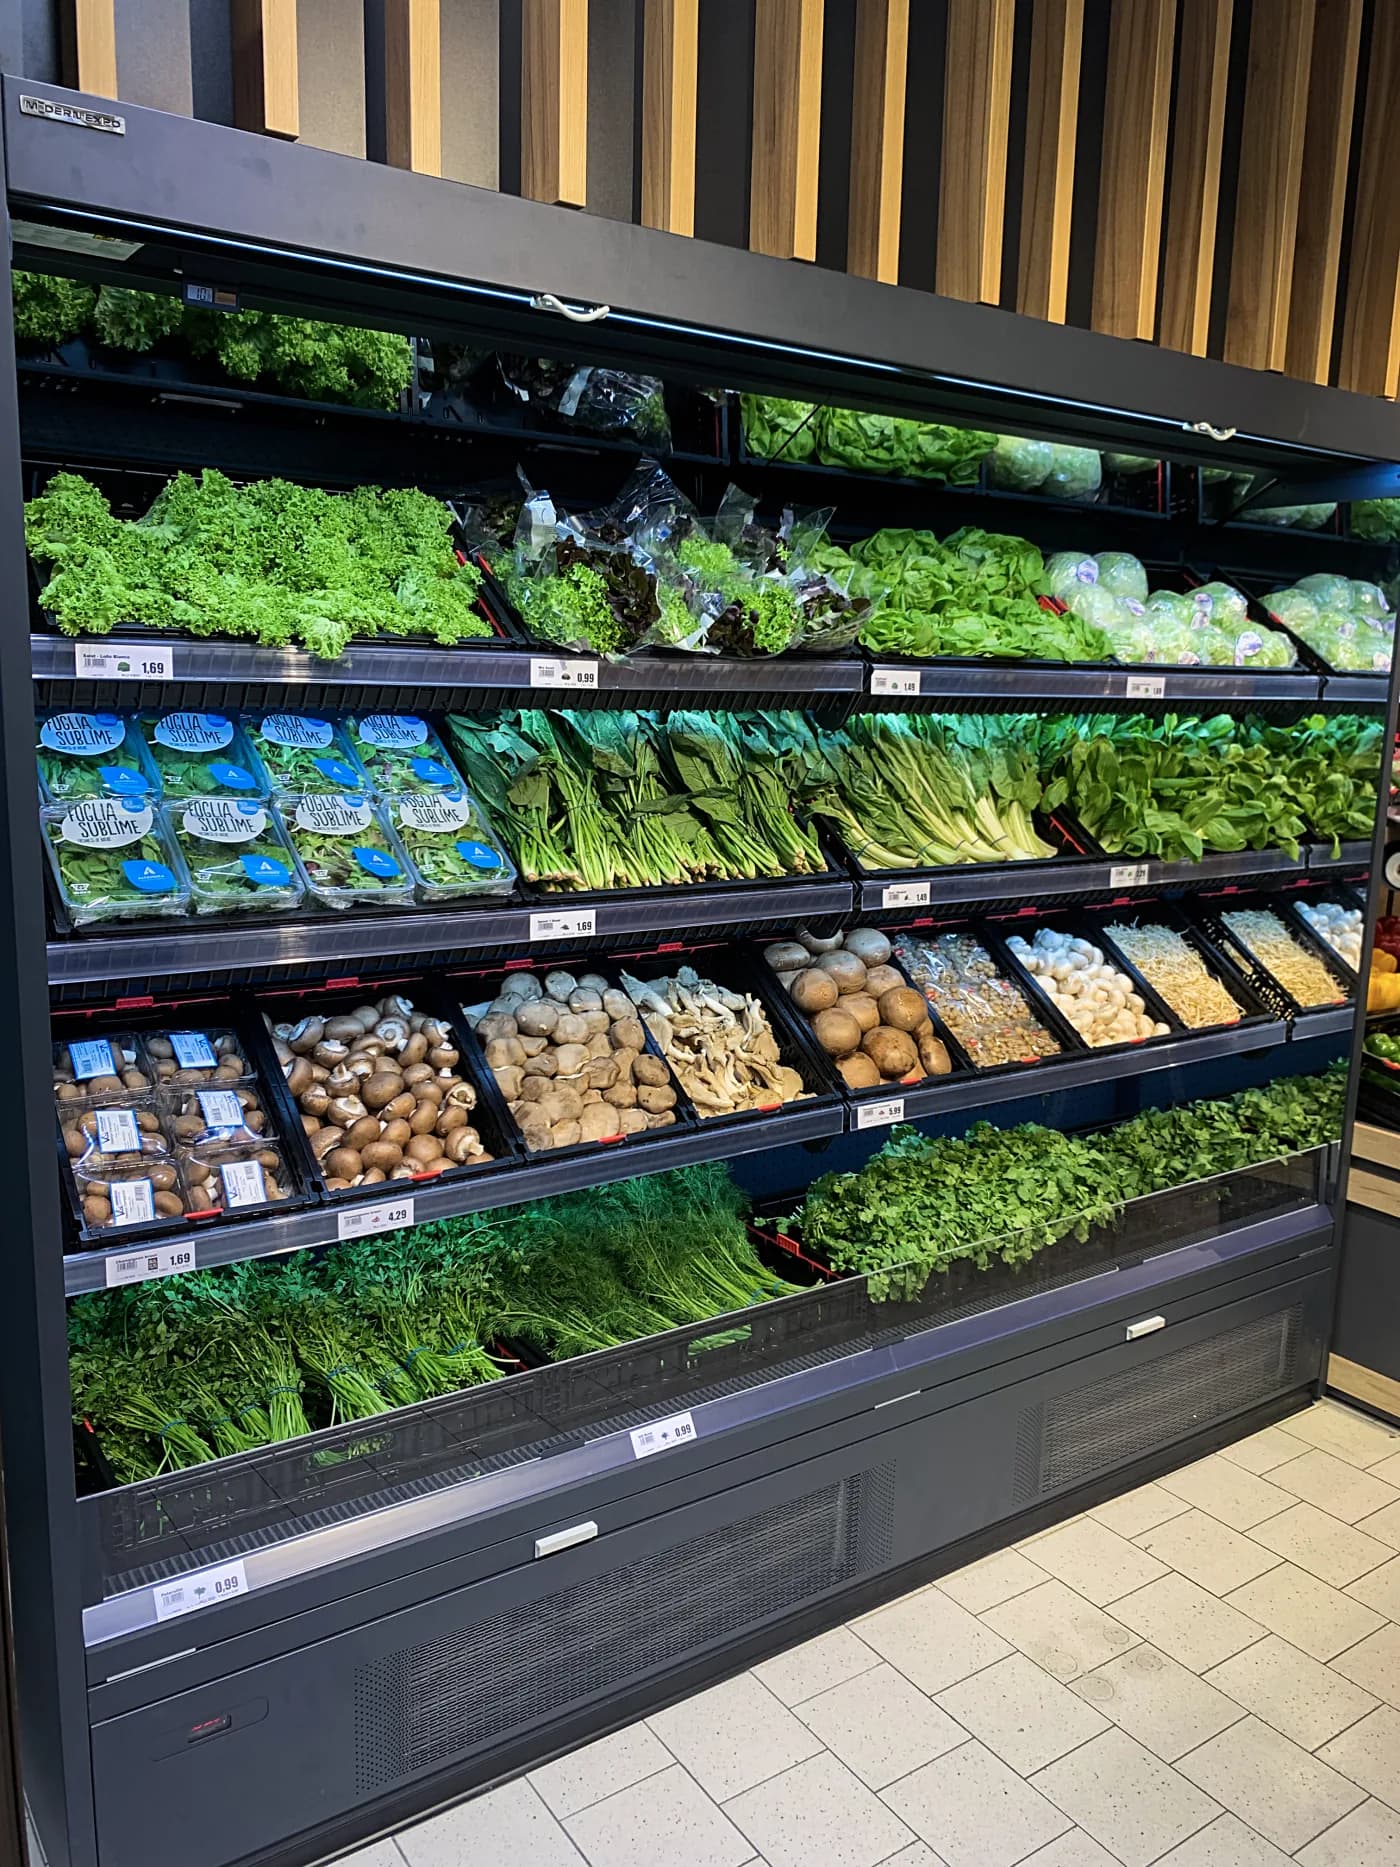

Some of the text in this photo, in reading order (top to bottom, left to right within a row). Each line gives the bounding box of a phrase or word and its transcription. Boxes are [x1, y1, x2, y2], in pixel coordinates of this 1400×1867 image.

[141, 662, 164, 674] 1,69
[577, 673, 594, 683] 0,99
[56, 729, 116, 746] SUBLIME
[169, 729, 225, 744] SUBLIME
[274, 725, 326, 745] SUBLIME
[371, 727, 420, 742] SUBLIME
[310, 810, 365, 827] SUBLIME
[412, 808, 464, 824] SUBLIME
[78, 820, 142, 838] SUBLIME
[198, 817, 257, 833] SUBLIME
[576, 921, 592, 931] 1,69
[388, 1209, 407, 1221] 4,29
[169, 1252, 191, 1266] 1,69
[674, 1423, 692, 1438] 0,99
[215, 1575, 239, 1594] 0,99
